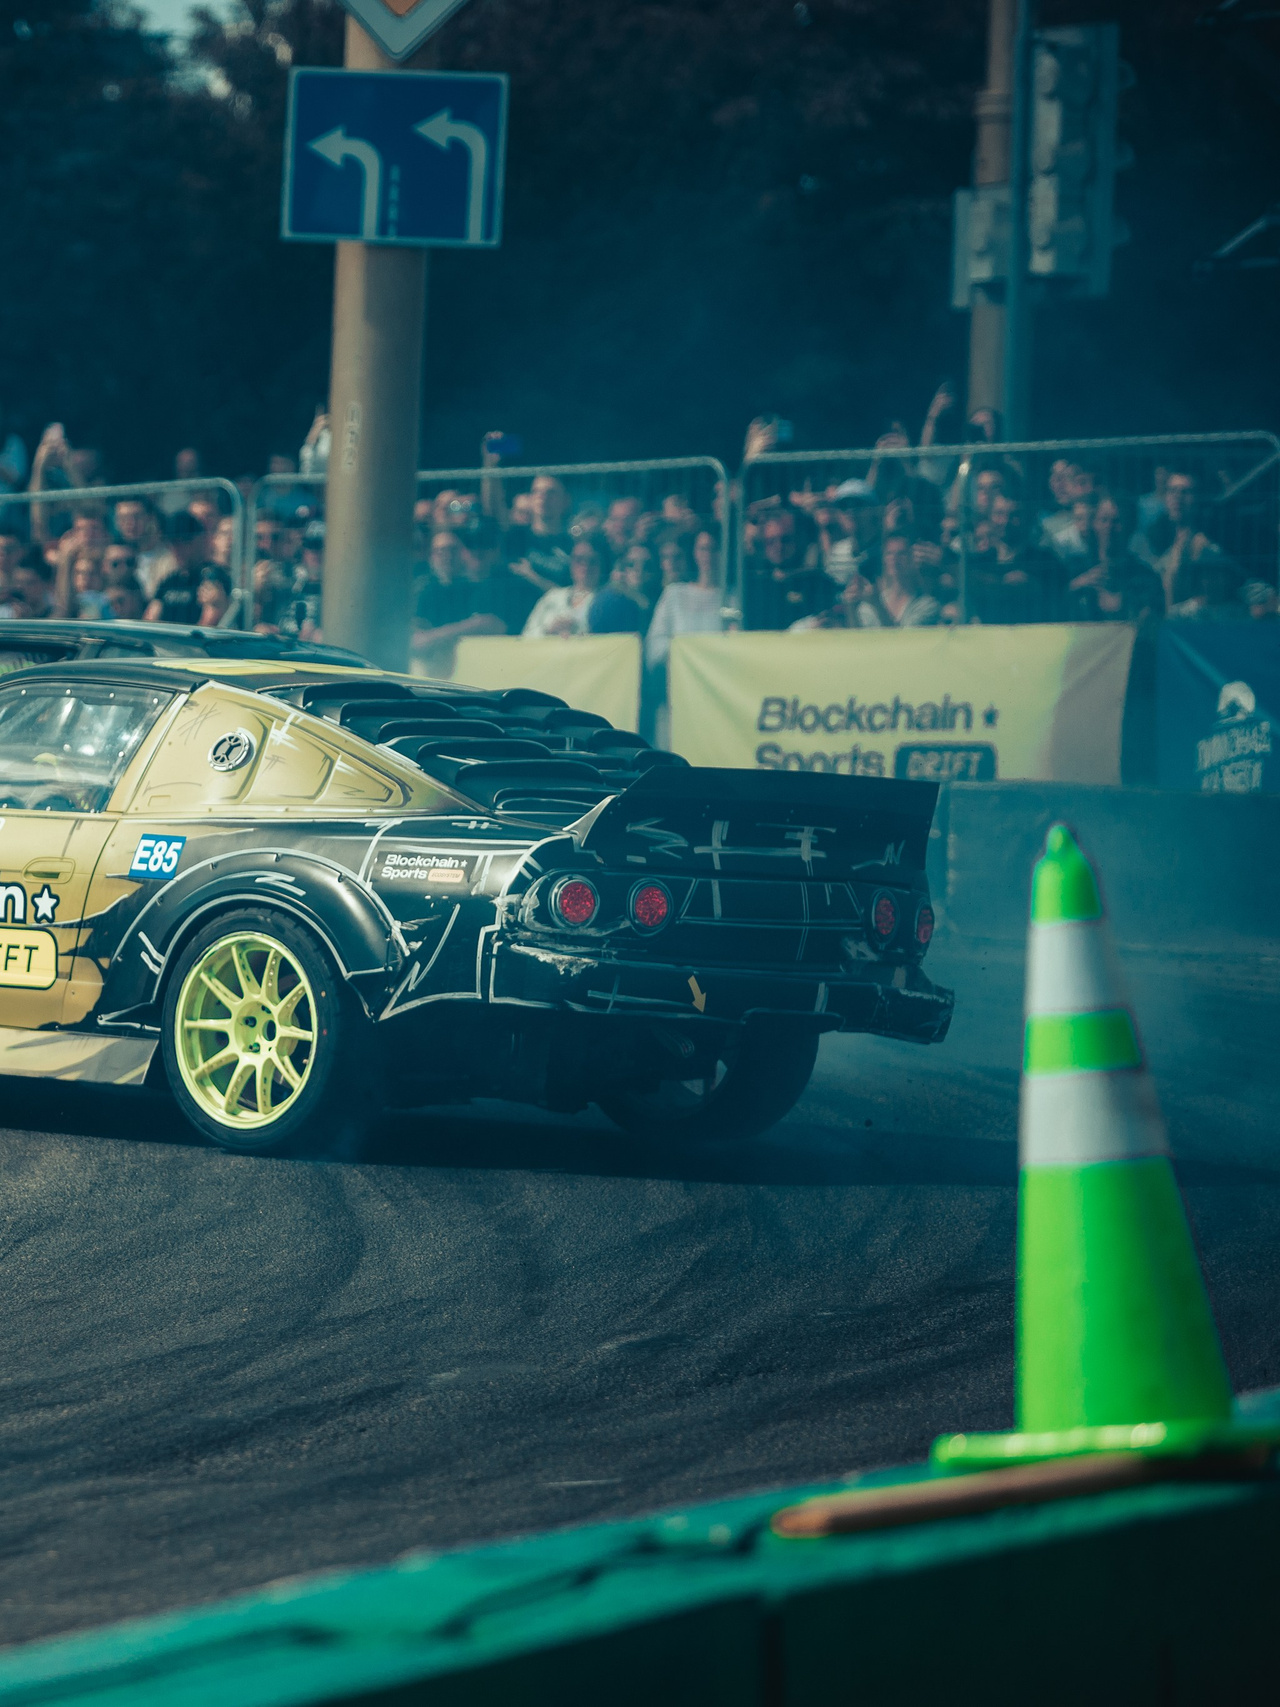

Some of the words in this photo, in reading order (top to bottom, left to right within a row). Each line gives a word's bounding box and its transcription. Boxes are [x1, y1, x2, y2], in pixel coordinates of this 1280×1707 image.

[757, 694, 973, 734] Blockchain
[131, 839, 183, 873] E85
[384, 854, 460, 868] Blockchain
[381, 866, 428, 880] Sports
